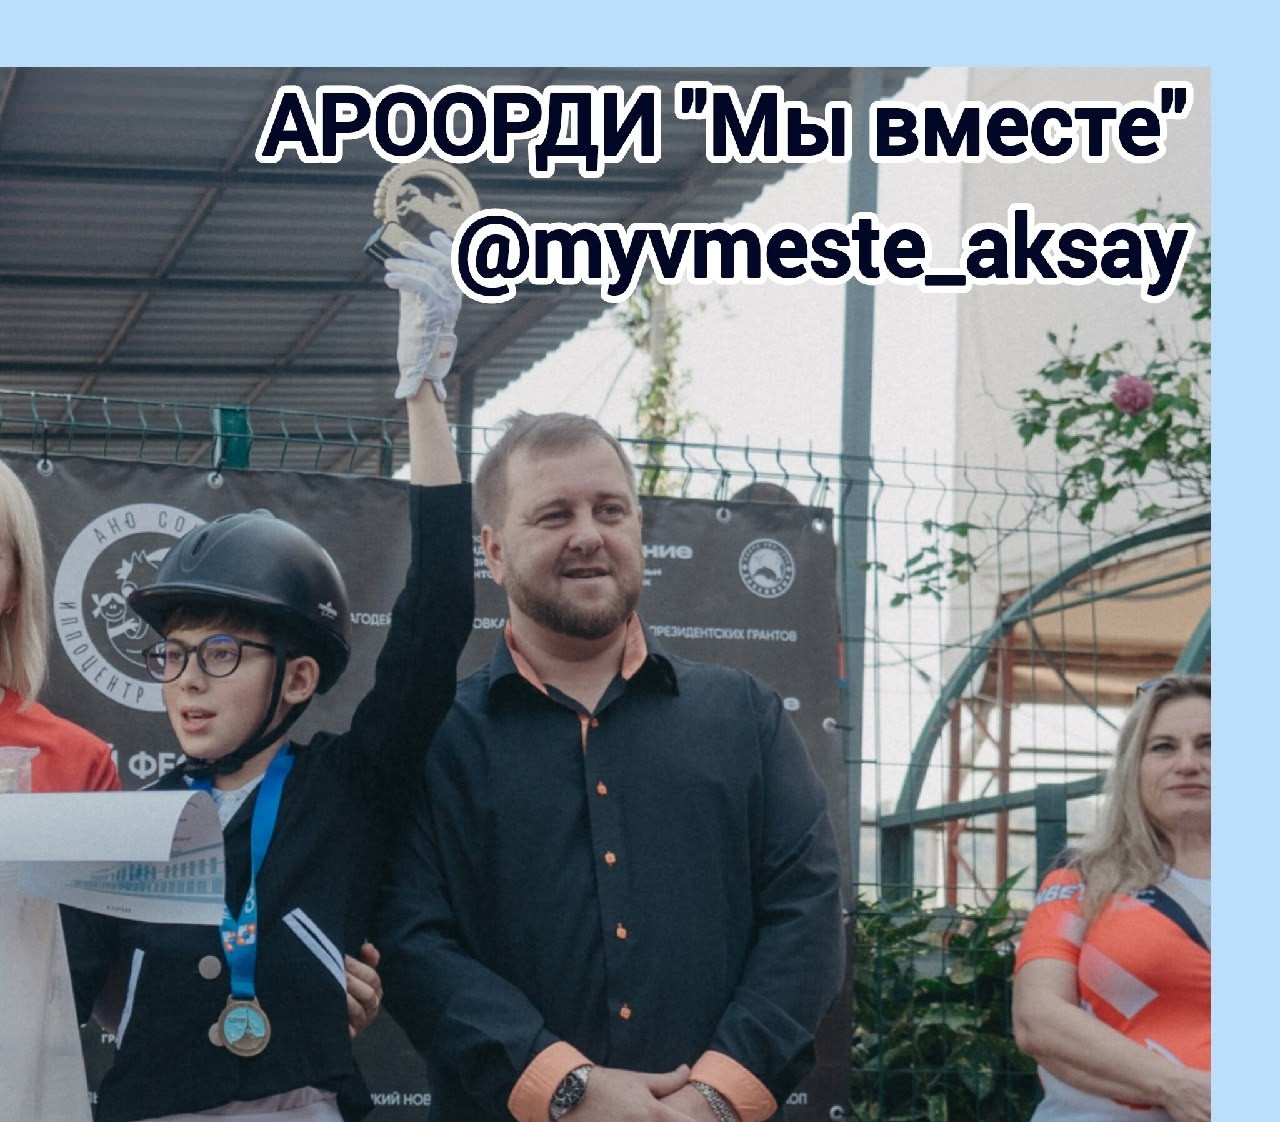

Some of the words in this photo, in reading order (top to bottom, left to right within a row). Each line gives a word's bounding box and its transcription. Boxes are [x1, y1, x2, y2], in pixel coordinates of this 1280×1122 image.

[747, 628, 798, 642] ГРАНТОВ
[59, 601, 145, 704] ИППОЦЕНТР
[128, 750, 186, 780] ФЕ
